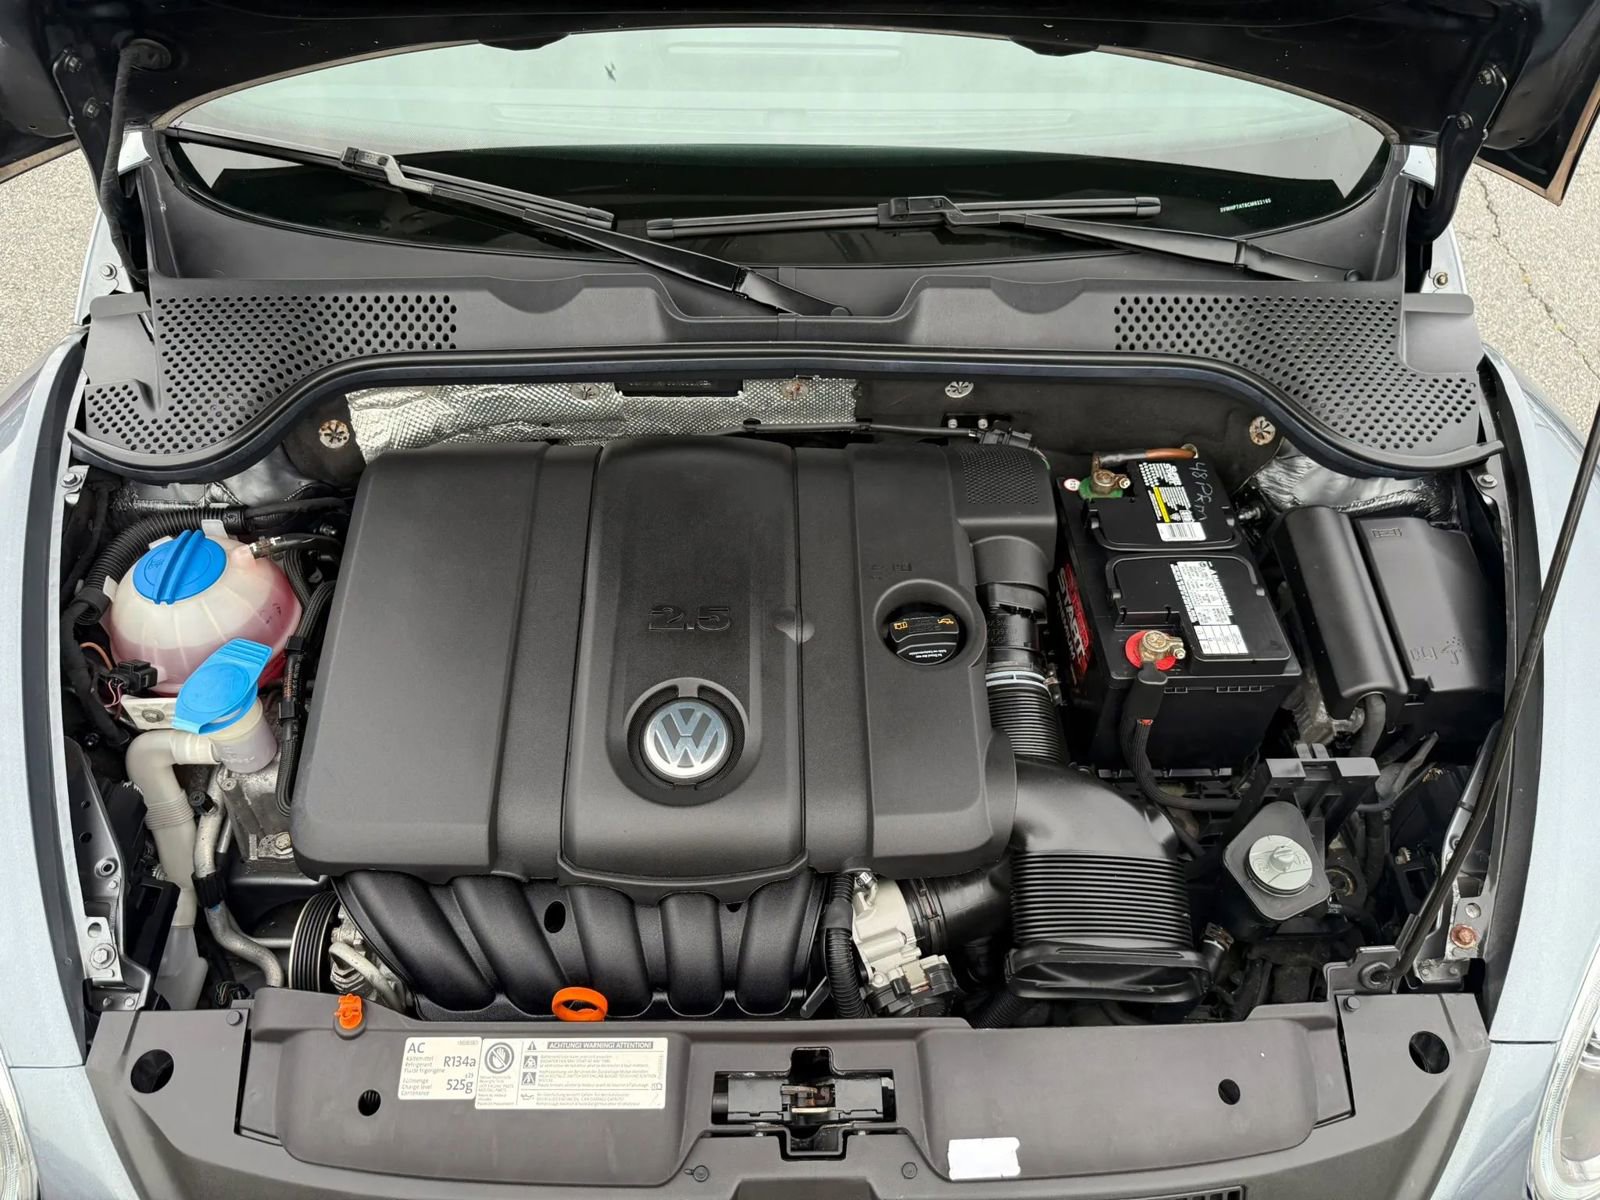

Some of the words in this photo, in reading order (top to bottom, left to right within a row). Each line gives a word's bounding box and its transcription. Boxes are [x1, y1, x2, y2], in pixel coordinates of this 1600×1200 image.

[649, 605, 731, 631] 2.5
[648, 701, 726, 774] VW
[407, 1042, 426, 1054] AC
[583, 1041, 616, 1049] WARNING!
[615, 1041, 652, 1049] ATTENTION!
[443, 1055, 477, 1068] R134a
[446, 1078, 474, 1095] 525g
